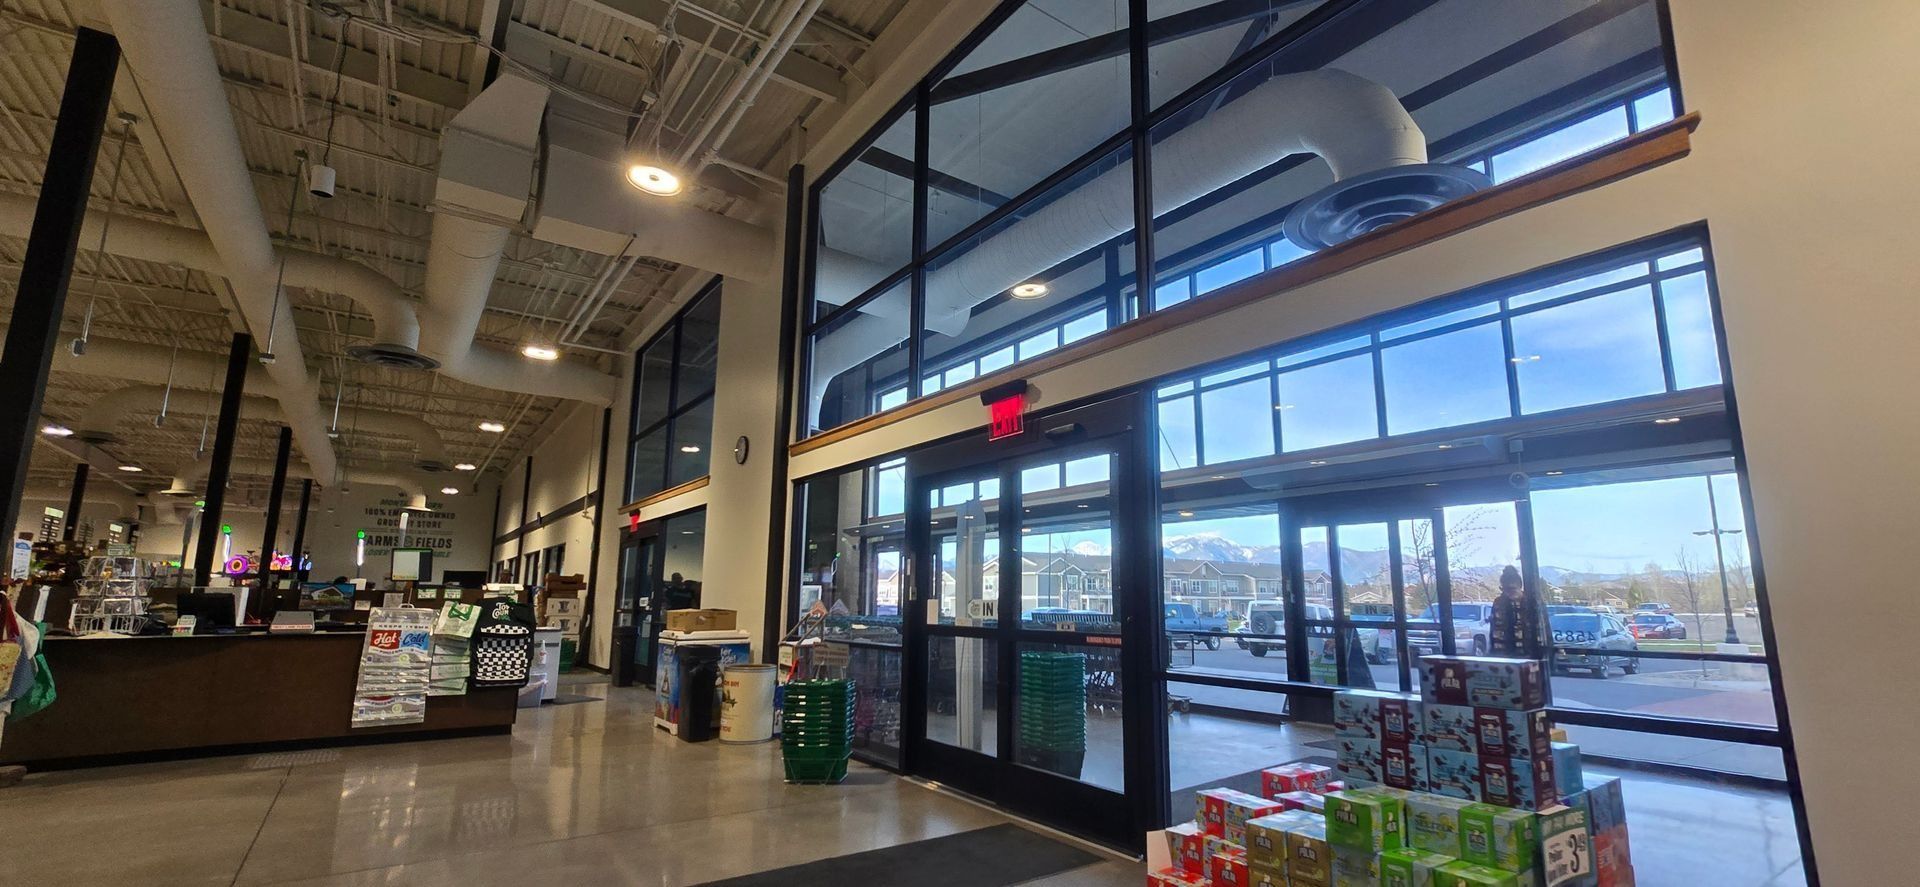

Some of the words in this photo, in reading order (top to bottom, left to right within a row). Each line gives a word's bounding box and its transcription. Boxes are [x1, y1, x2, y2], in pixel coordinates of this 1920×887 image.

[415, 537, 453, 549] FIELDS
[982, 602, 994, 617] IN
[373, 632, 397, 647] Hot
[402, 632, 427, 647] Cold
[1299, 847, 1317, 860] POLAR
[1222, 870, 1236, 881] POLAR
